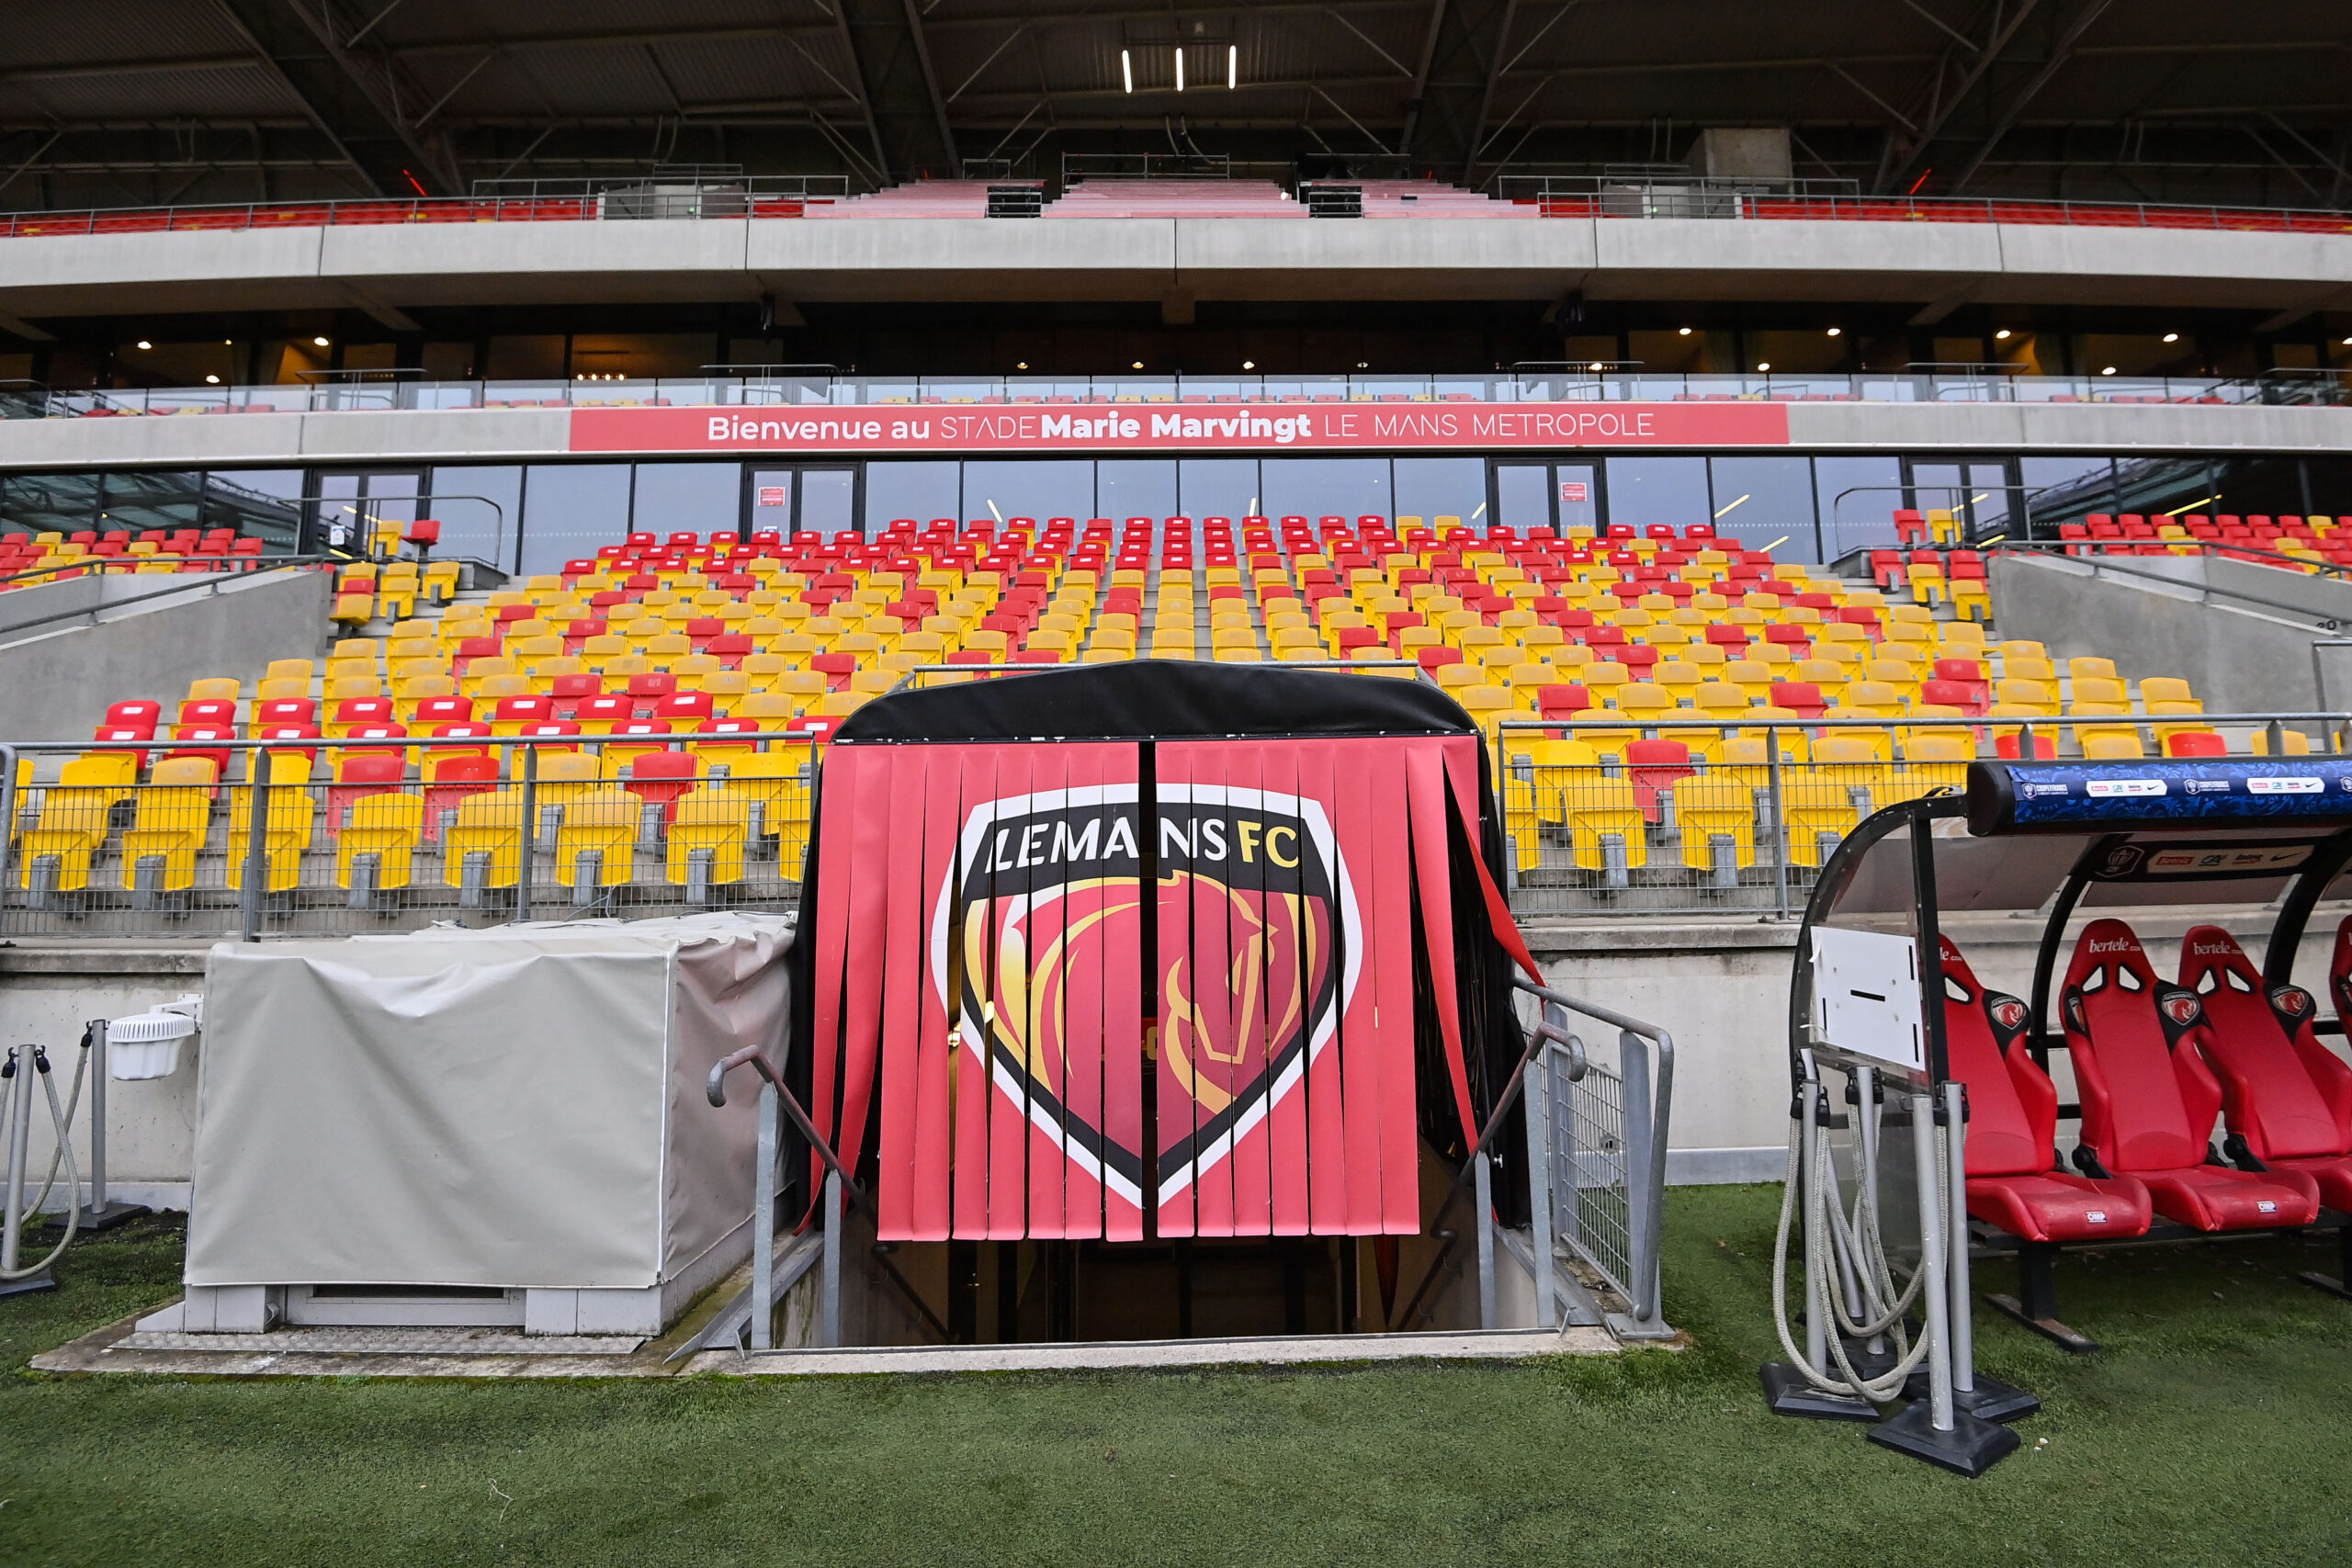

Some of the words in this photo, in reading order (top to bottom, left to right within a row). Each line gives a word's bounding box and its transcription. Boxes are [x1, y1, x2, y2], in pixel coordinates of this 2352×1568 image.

[707, 415, 882, 441] Bienvenue
[891, 421, 930, 440] au
[941, 415, 1036, 439] STADE
[1041, 411, 1141, 439] Marie
[1151, 410, 1313, 444] Marvingt
[1325, 414, 1359, 437] LE
[1375, 413, 1459, 436] MANS
[1473, 412, 1656, 436] METROPOLE
[1237, 819, 1300, 869] FC
